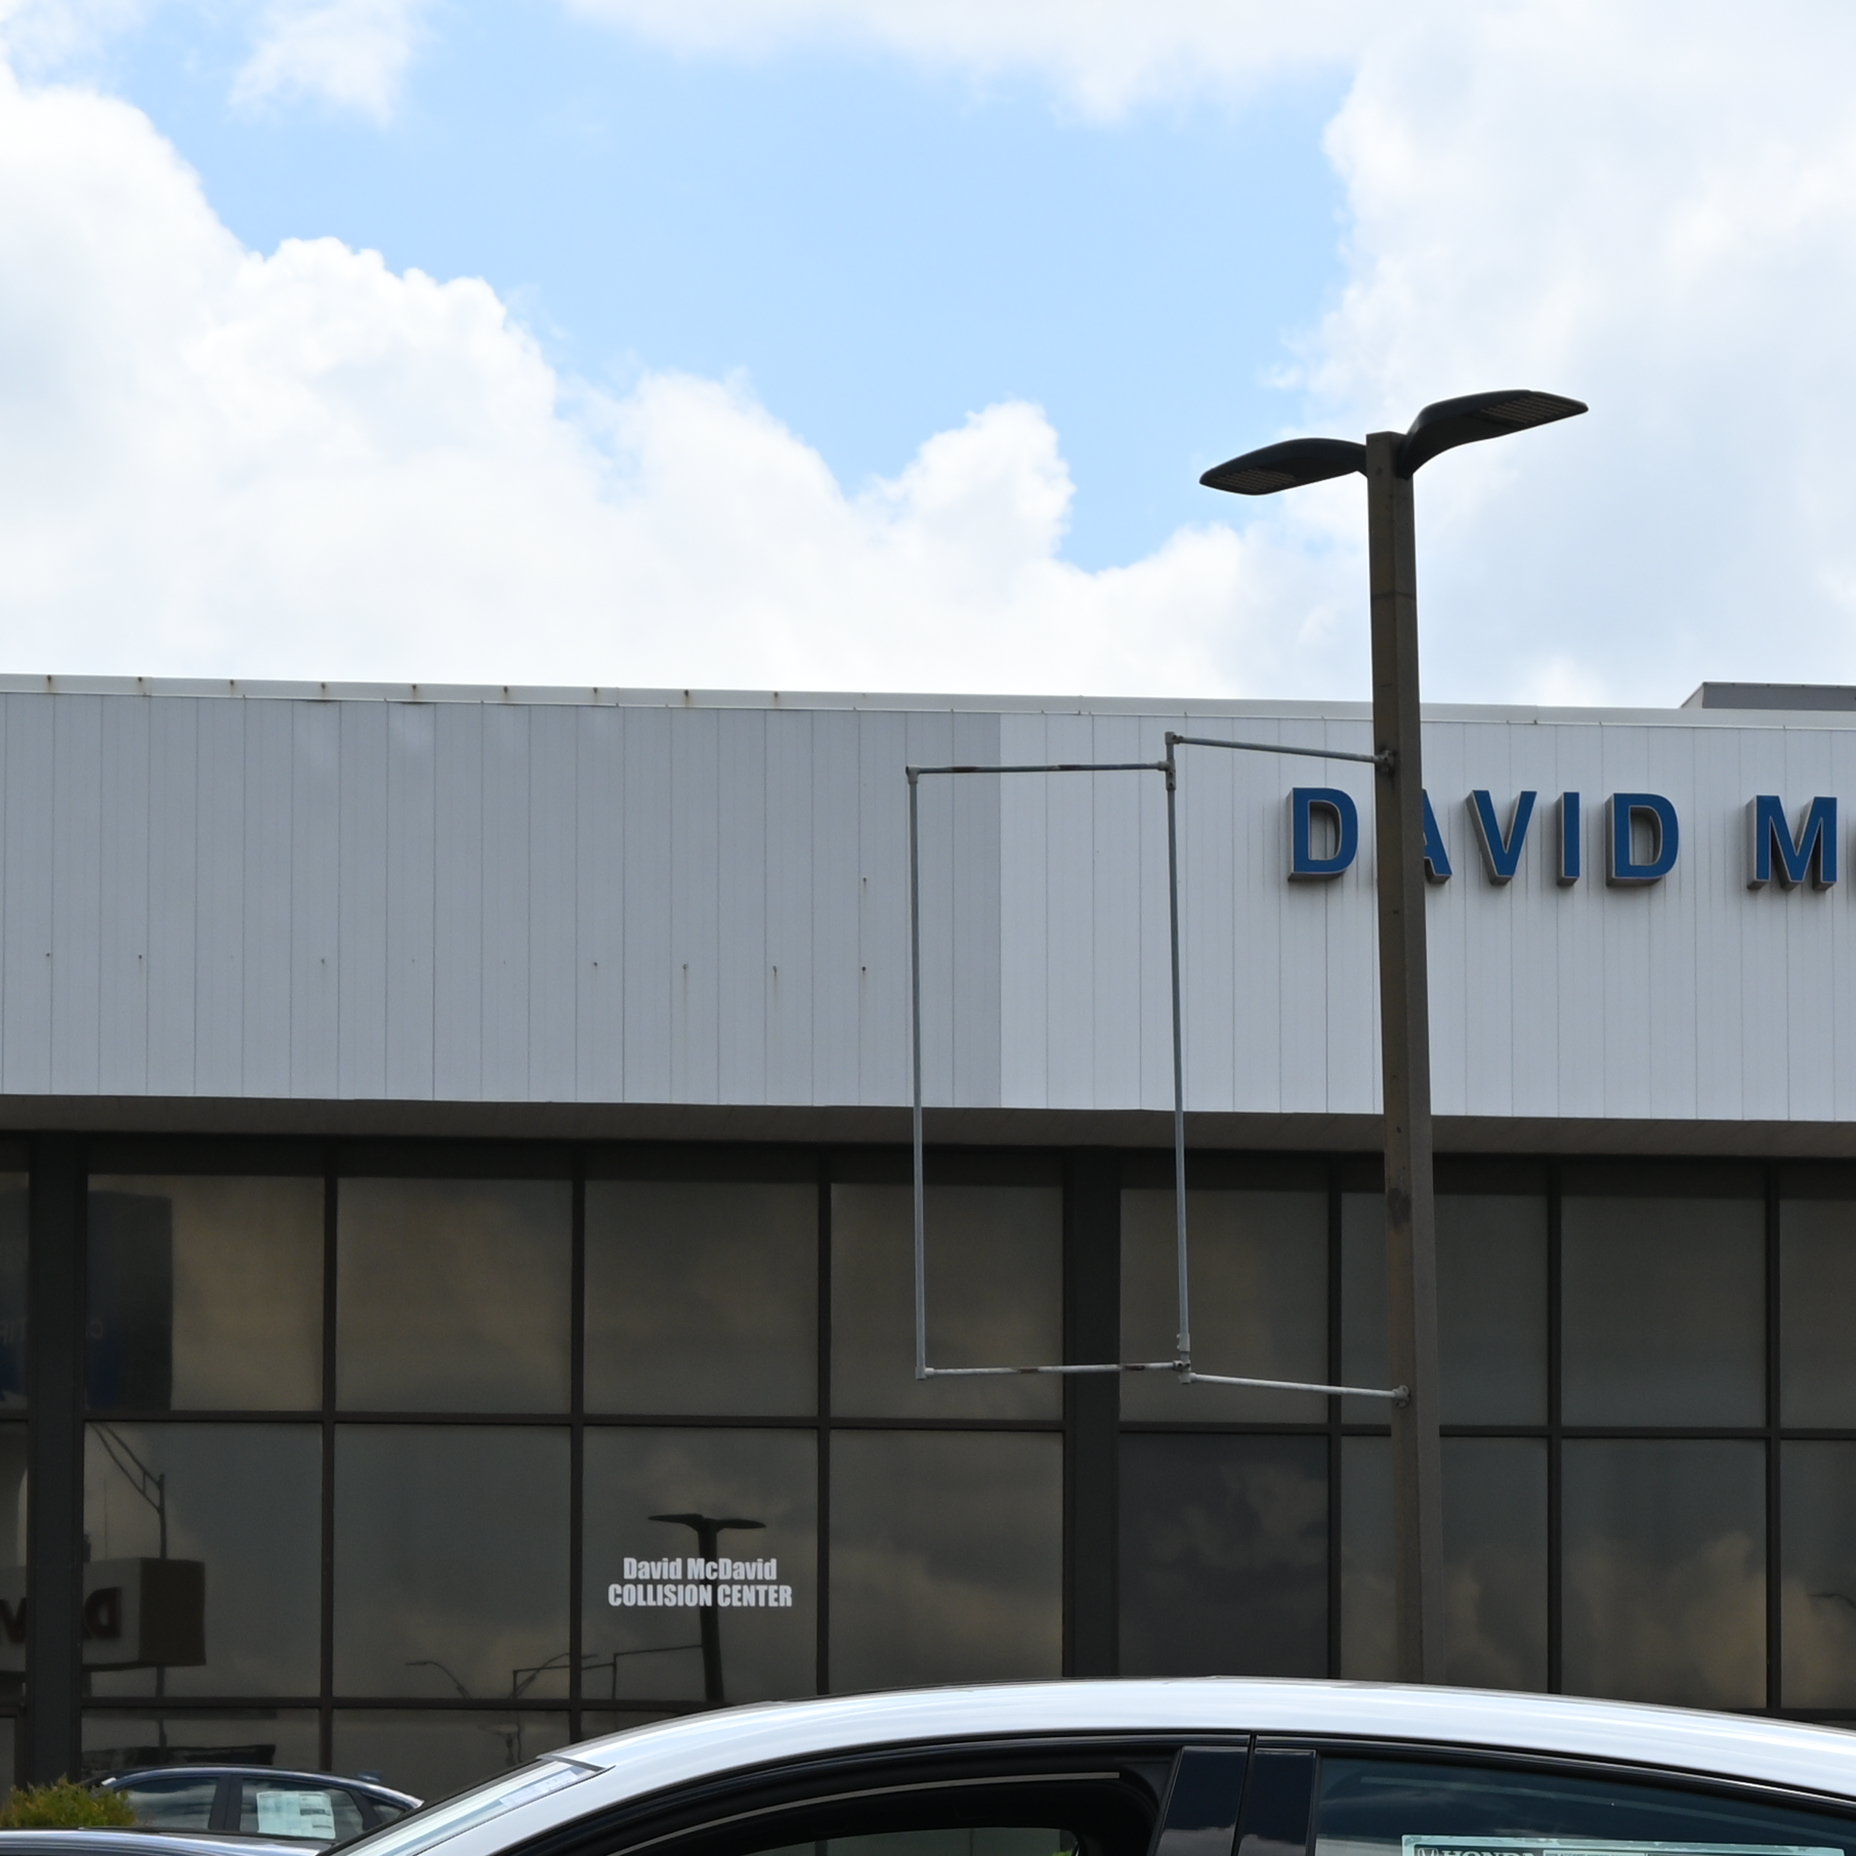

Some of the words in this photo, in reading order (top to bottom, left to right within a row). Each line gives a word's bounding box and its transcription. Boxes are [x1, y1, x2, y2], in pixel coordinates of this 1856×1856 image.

[623, 1557, 683, 1581] David
[686, 1558, 778, 1581] McDavid
[607, 1584, 714, 1608] COLLISION
[716, 1585, 793, 1608] CENTER
